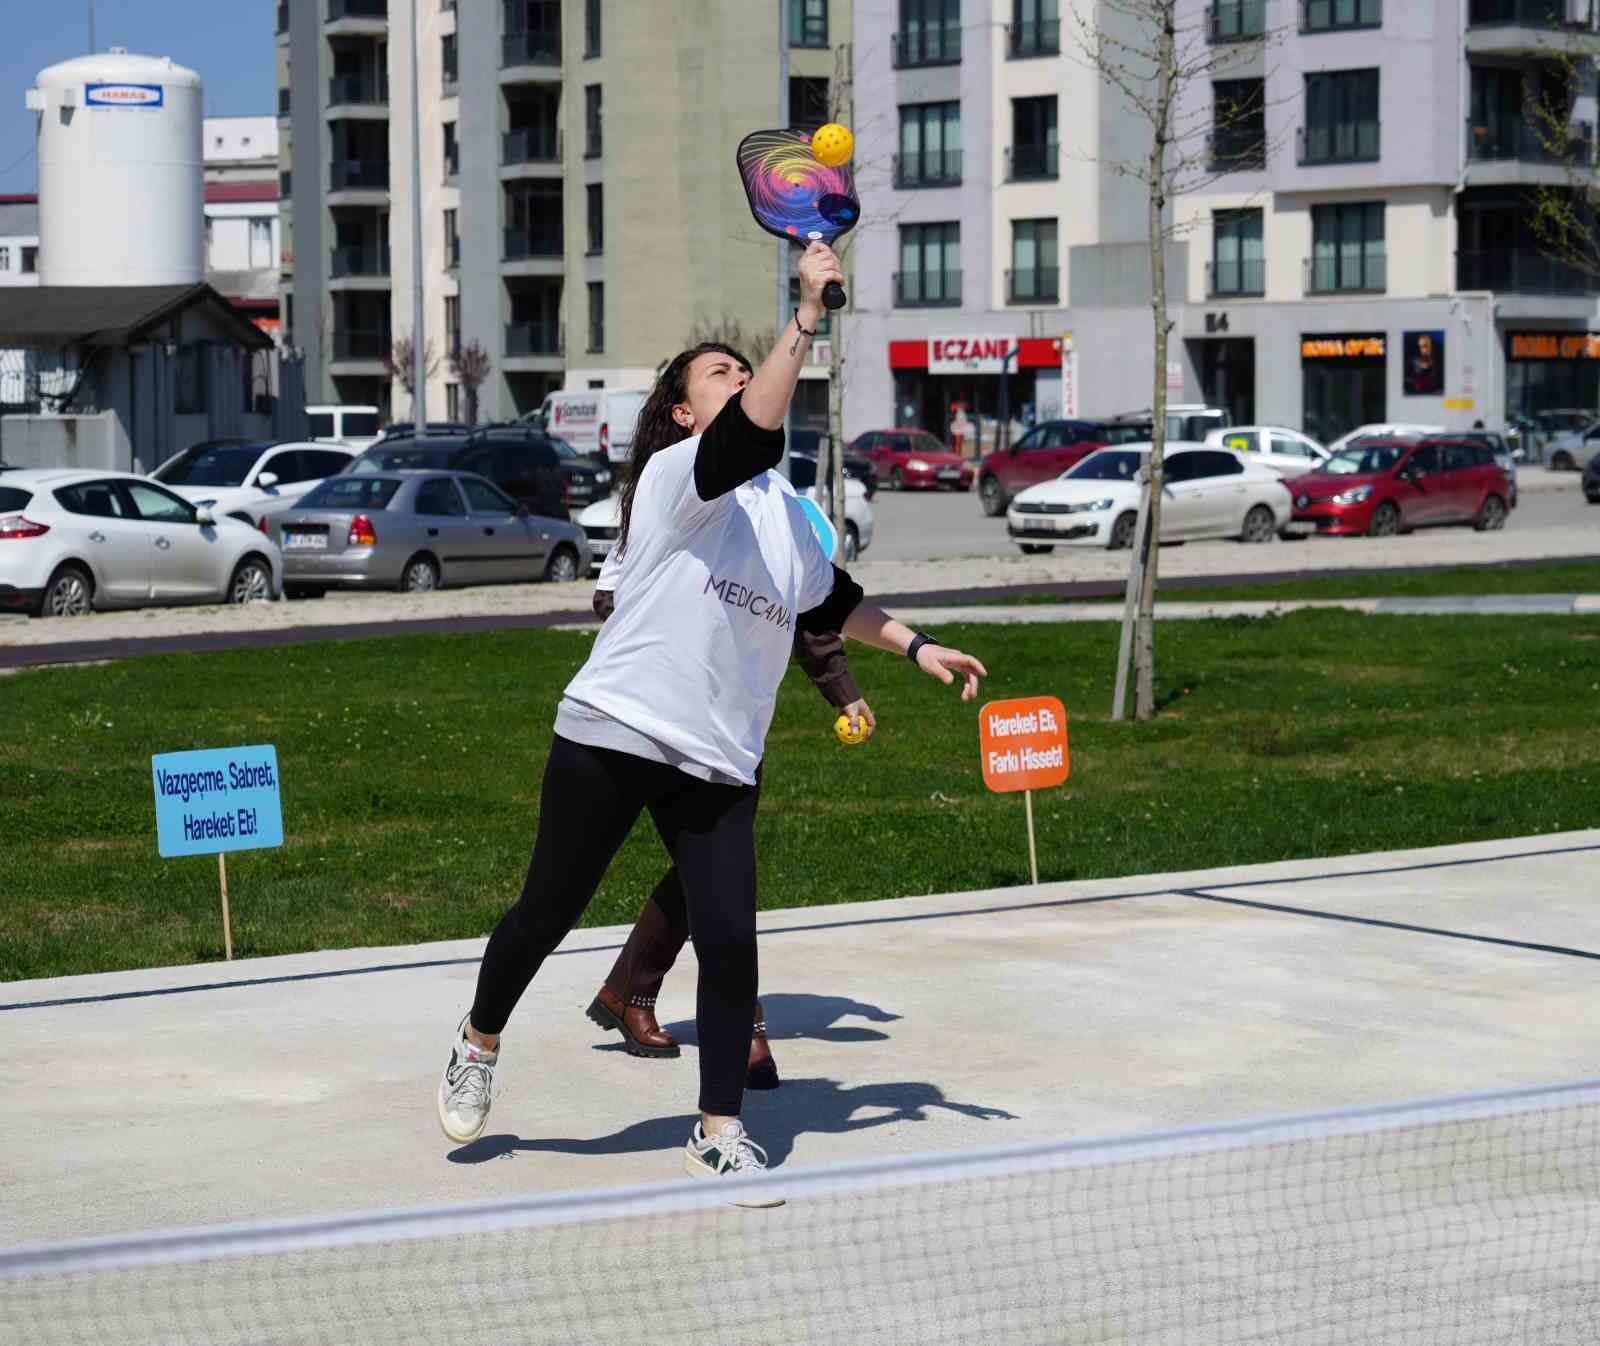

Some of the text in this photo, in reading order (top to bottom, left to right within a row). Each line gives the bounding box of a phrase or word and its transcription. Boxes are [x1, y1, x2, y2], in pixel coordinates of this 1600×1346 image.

[933, 339, 1009, 362] ECZANE
[703, 574, 792, 633] MEDICANA
[988, 711, 1037, 737] Hareket
[988, 744, 1063, 775] Farkı Hisset!
[157, 760, 276, 803] Vazgeçme, Sabret,
[183, 807, 258, 841] Hareket Et!
